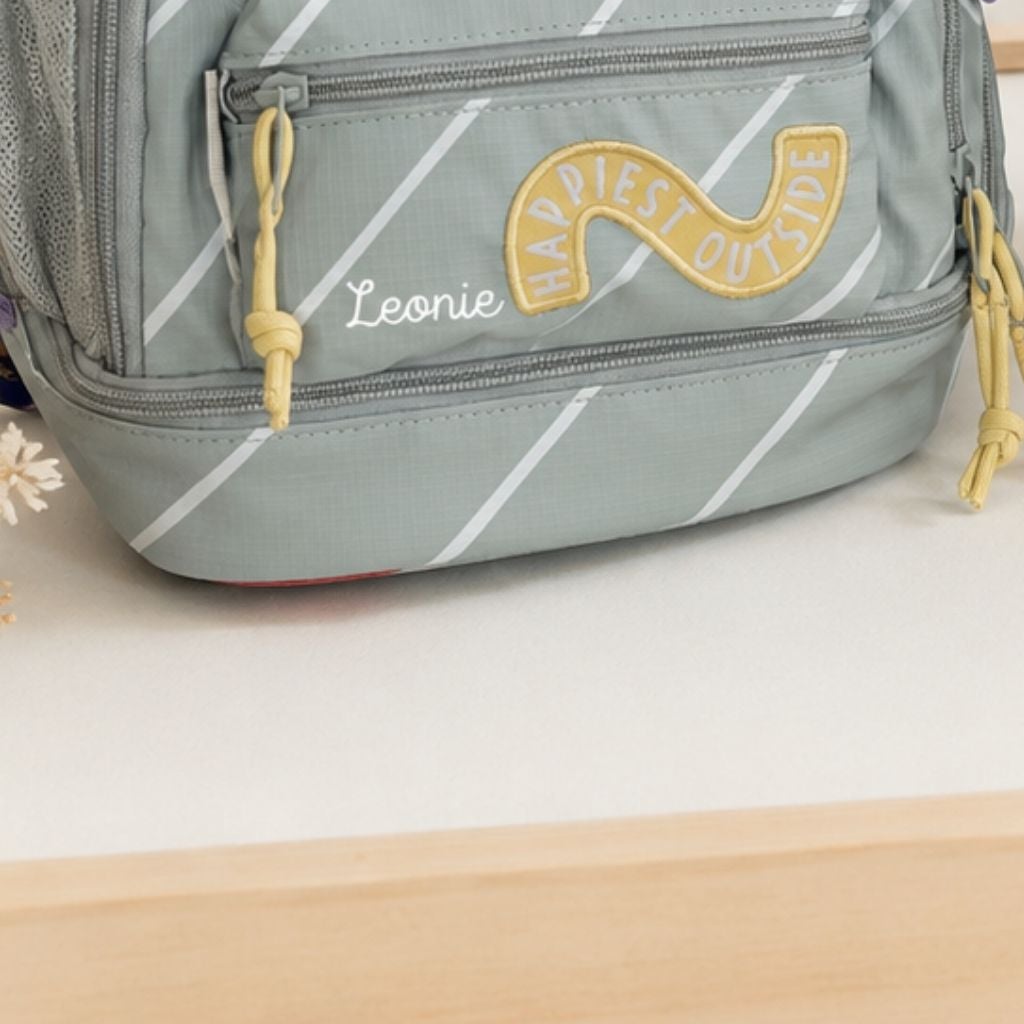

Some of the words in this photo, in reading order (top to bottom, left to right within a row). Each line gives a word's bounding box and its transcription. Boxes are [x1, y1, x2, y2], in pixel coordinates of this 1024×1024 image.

[525, 155, 697, 297] HAPPIEST
[693, 149, 831, 283] OUTSIDE
[346, 279, 504, 328] Leonie
